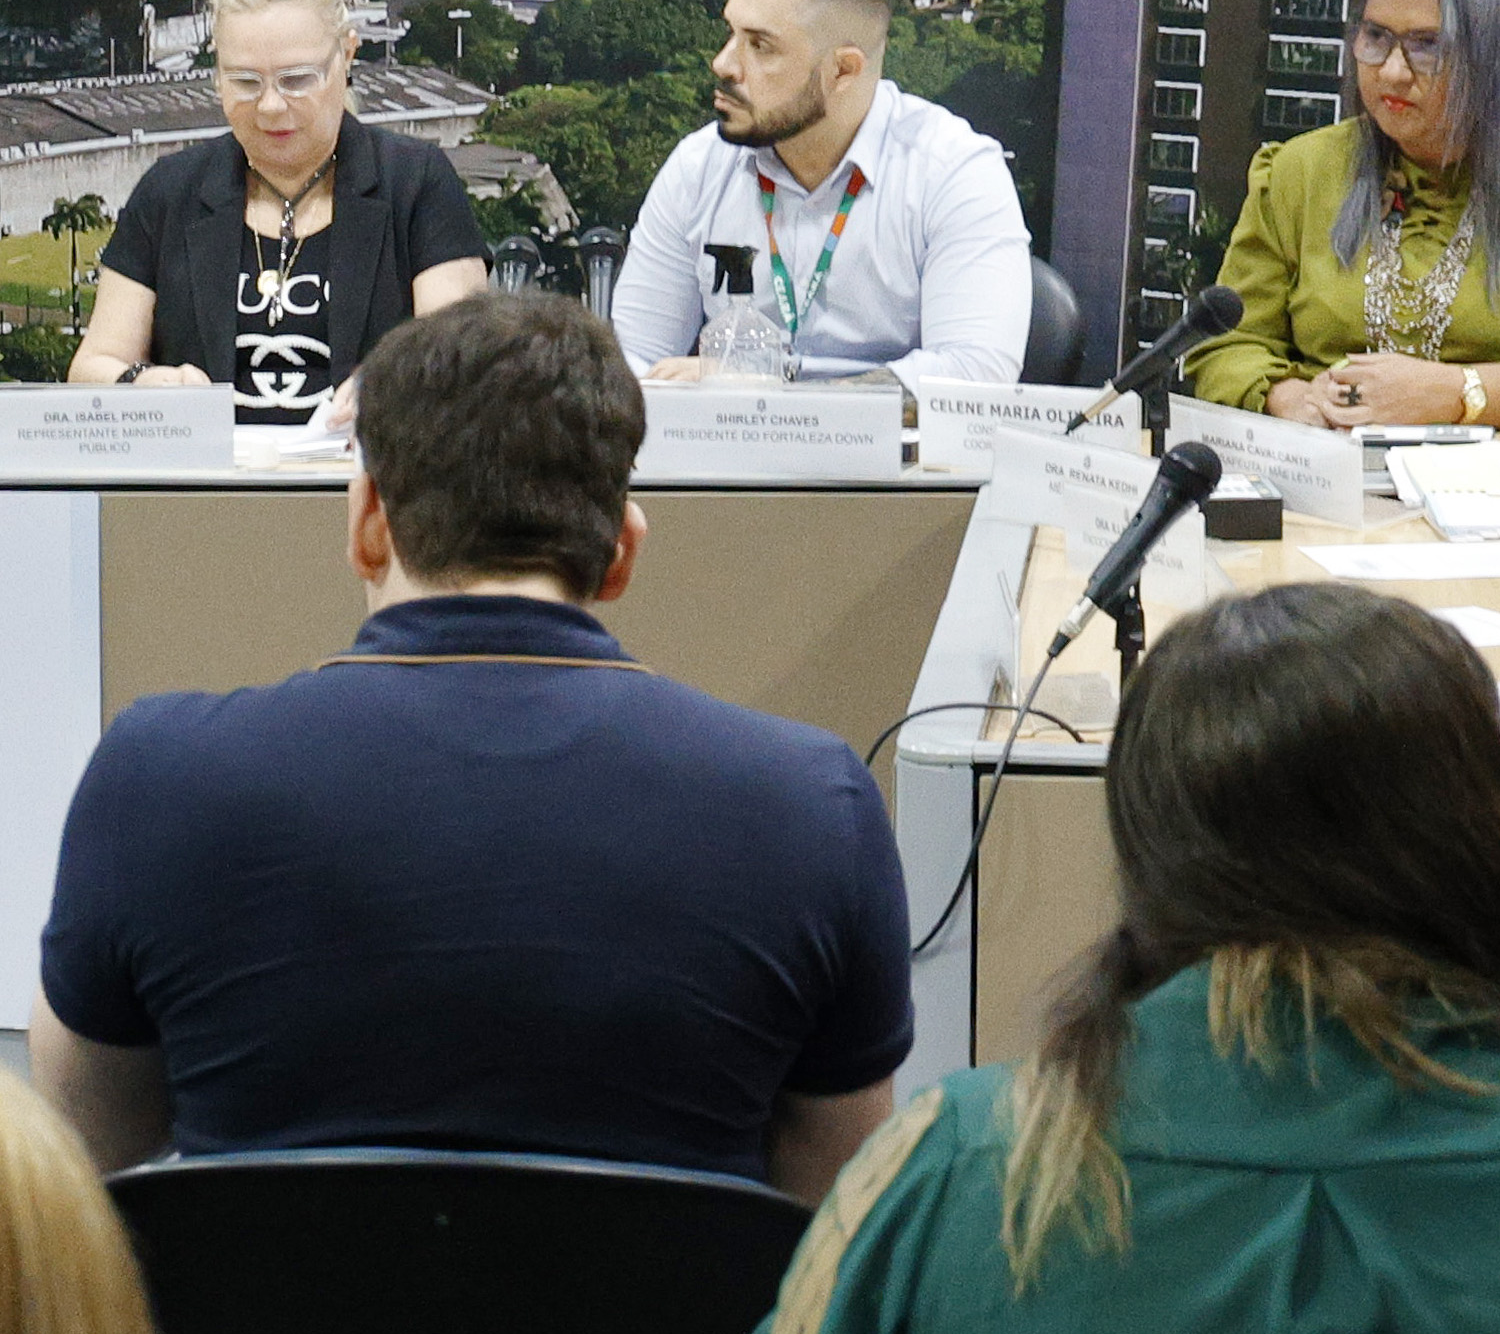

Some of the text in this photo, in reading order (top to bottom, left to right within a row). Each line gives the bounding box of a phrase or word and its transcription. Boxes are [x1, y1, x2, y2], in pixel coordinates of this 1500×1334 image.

[75, 411, 119, 423] ISABEL
[121, 411, 164, 423] PORTO
[716, 413, 820, 427] SHIRLEY CHAVES
[930, 398, 1126, 428] CELENE MARIA OLIIRA
[18, 426, 192, 440] REPRESENTANTE MINISTÉRIO
[663, 428, 875, 445] PRESIDENTE DO FORTALEZA DOWN
[1202, 433, 1311, 467] MARIANA CAVALCANTE
[1069, 468, 1106, 487] RENATA
